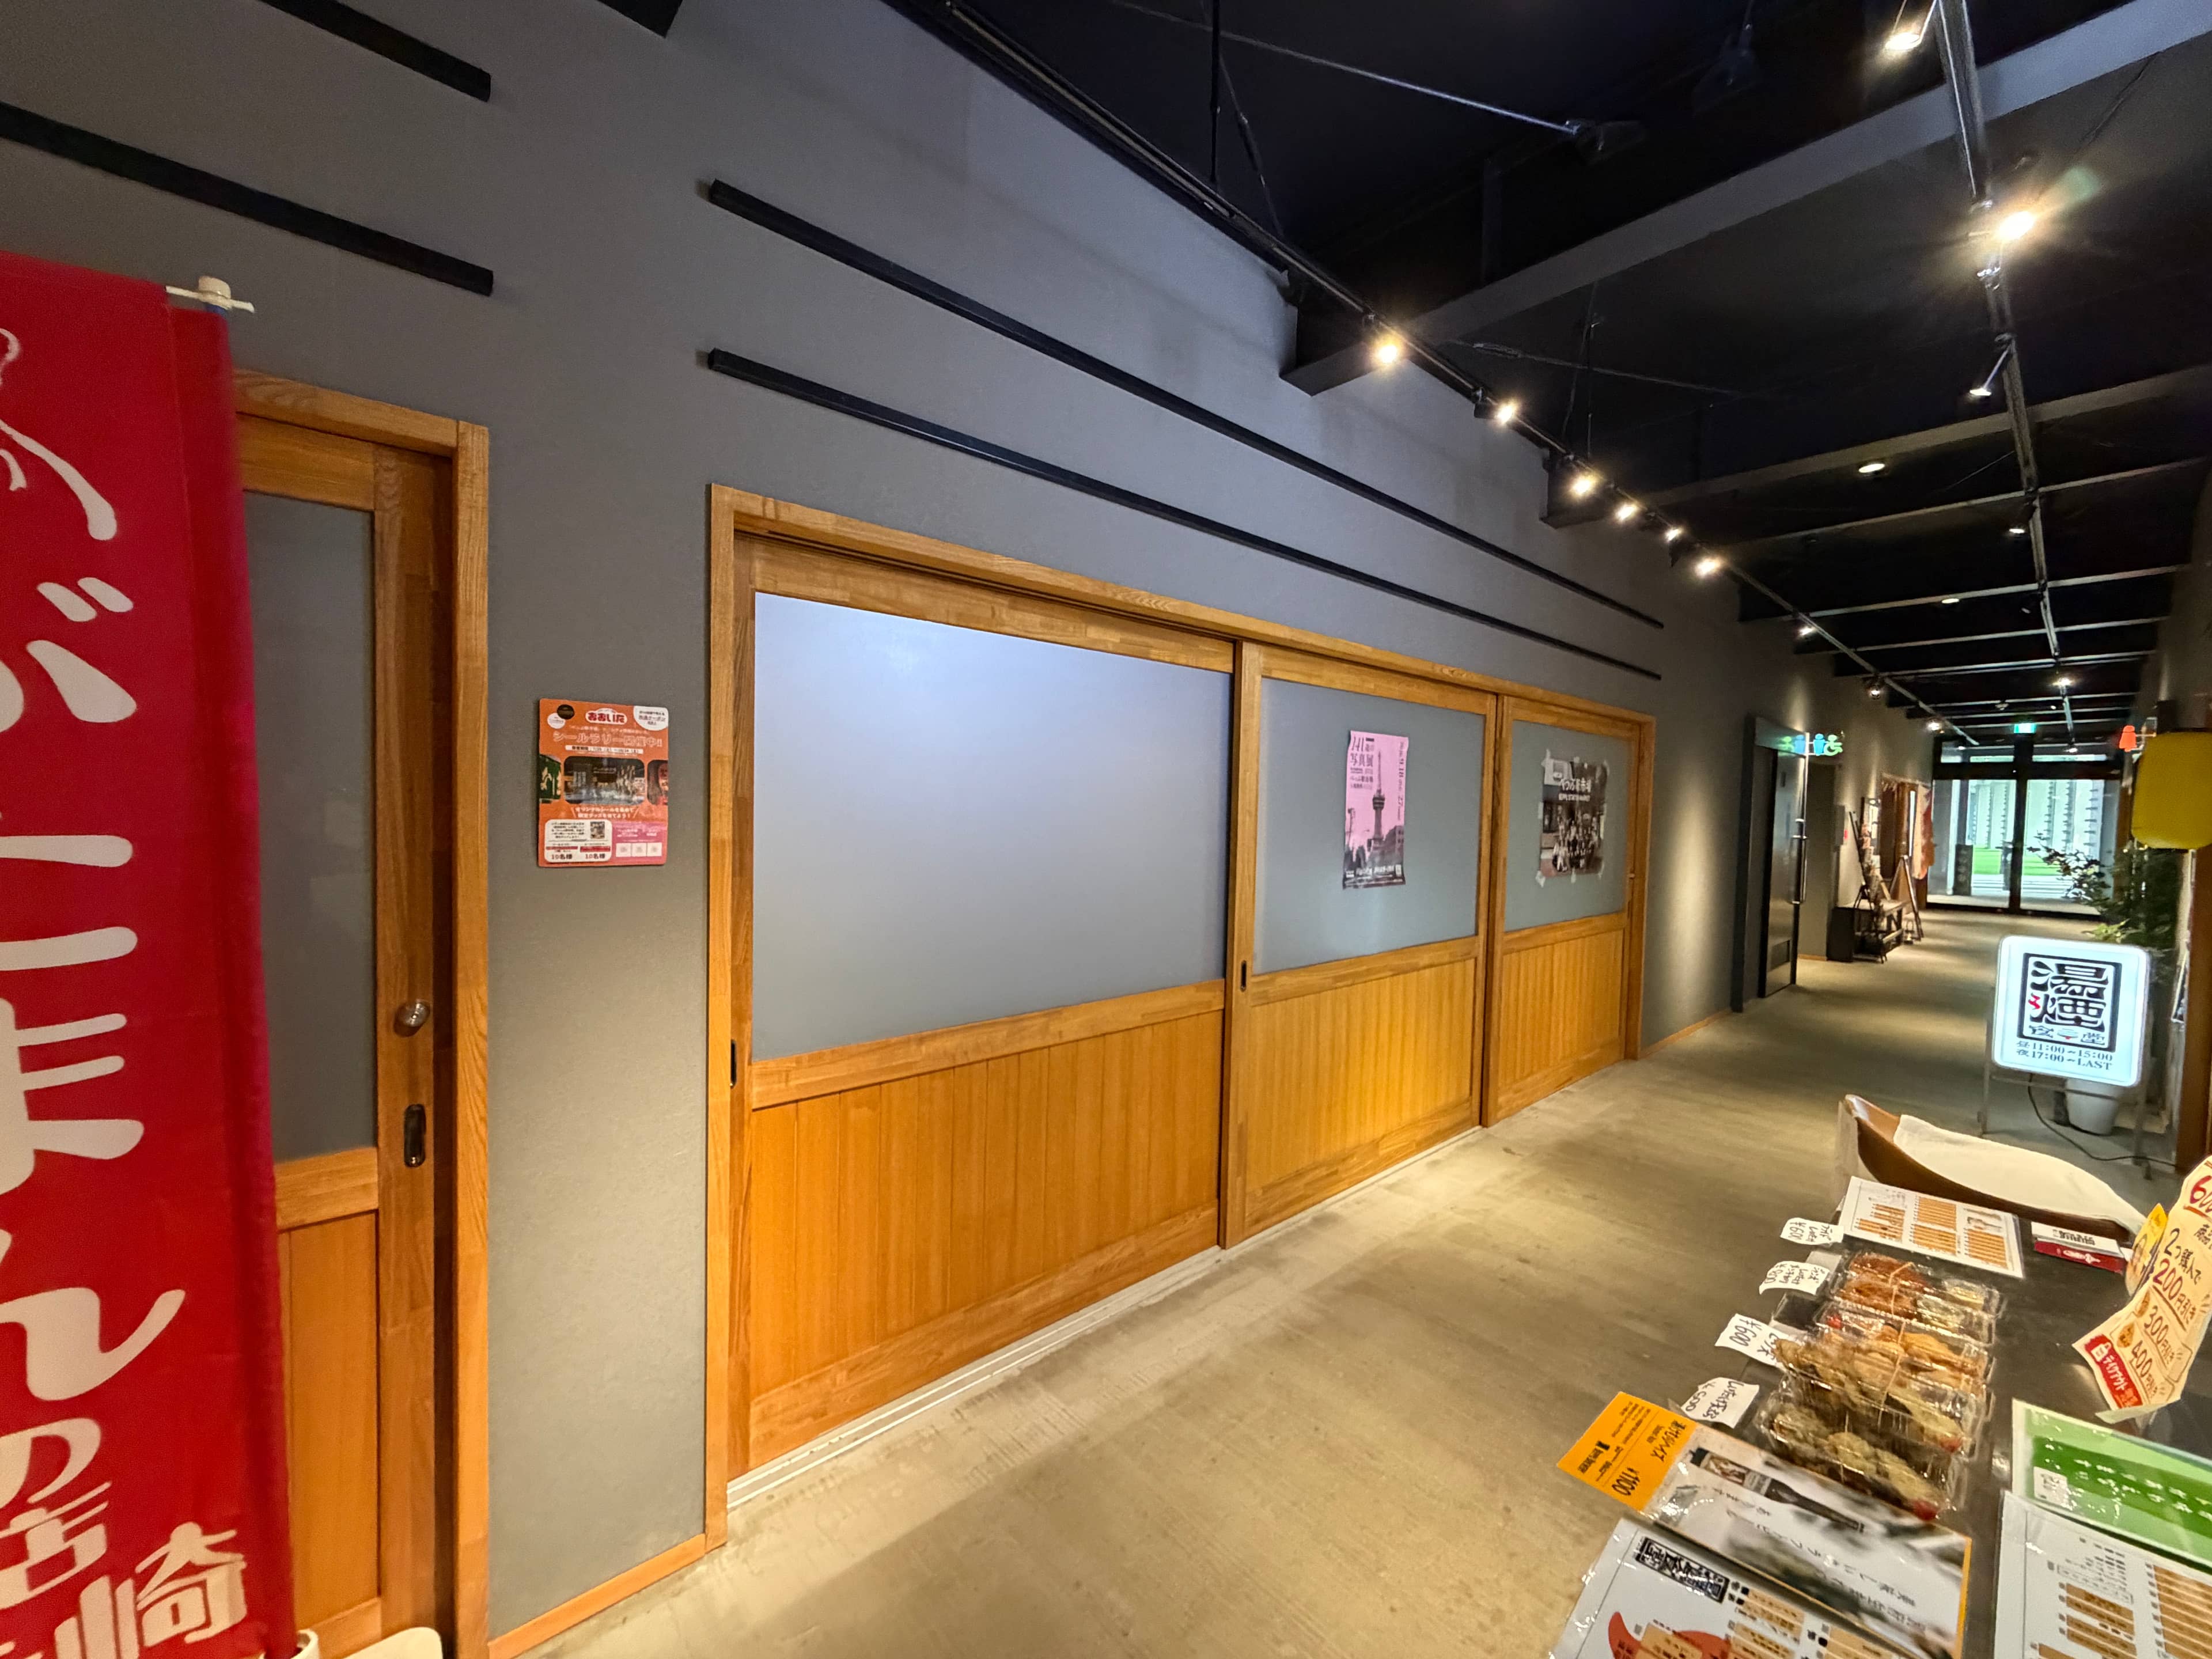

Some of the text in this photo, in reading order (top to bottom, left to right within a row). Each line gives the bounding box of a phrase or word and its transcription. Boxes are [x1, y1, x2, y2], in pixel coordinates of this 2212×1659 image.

[2153, 1257, 2196, 1324] 200円引き
[1729, 1318, 1763, 1347] ¥600
